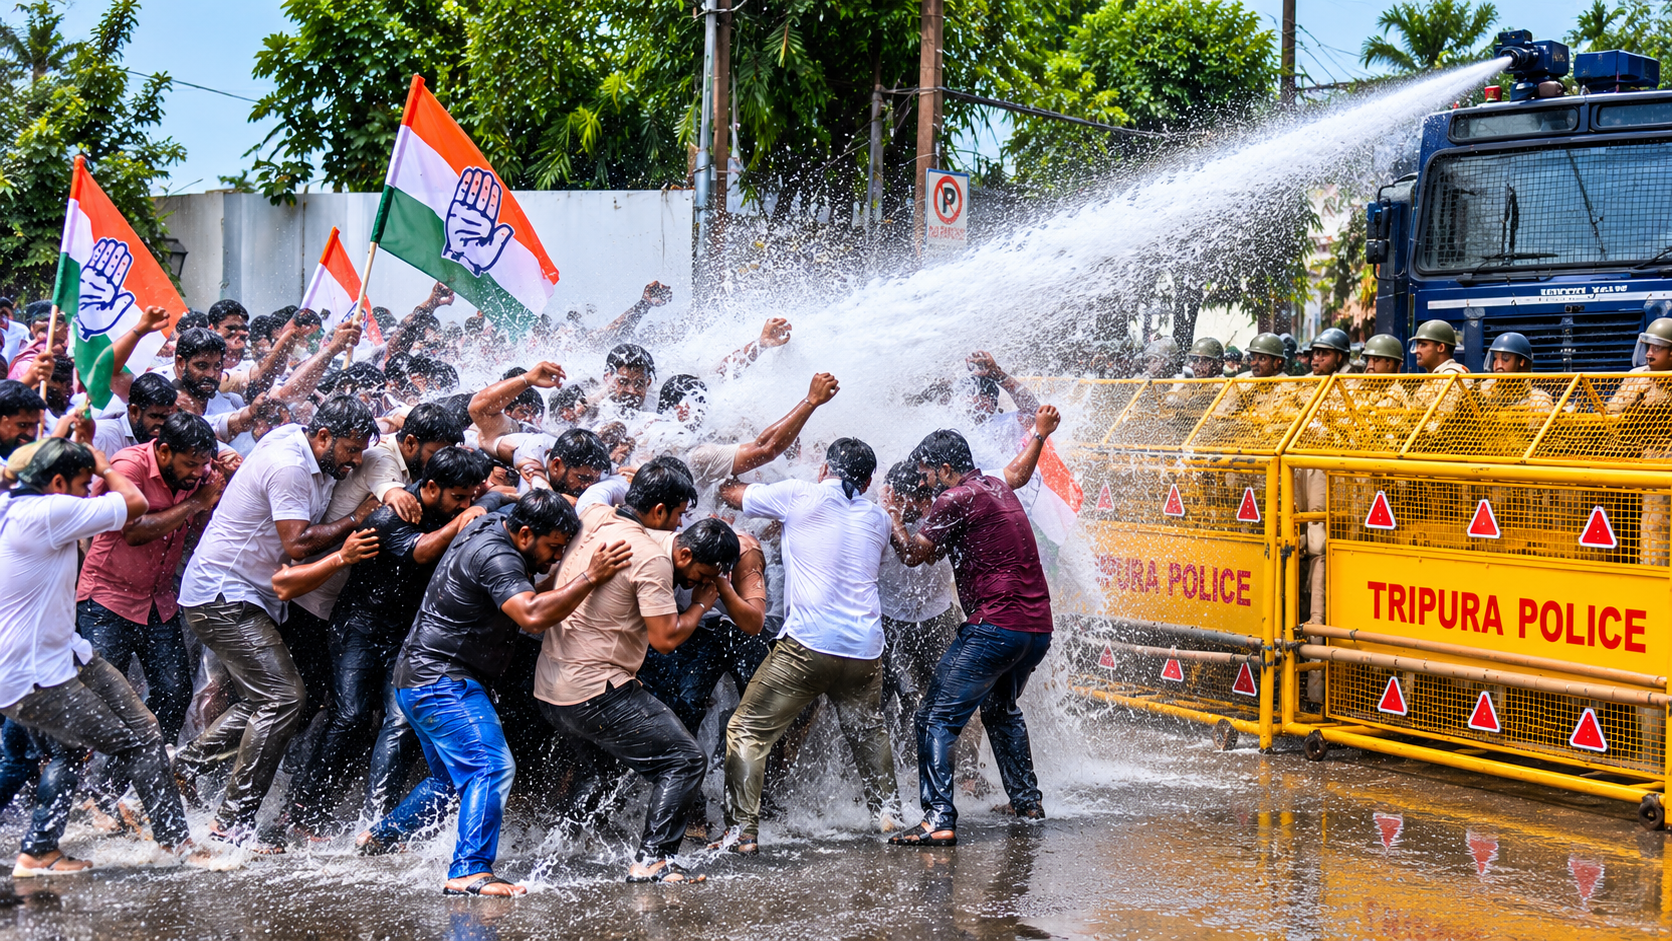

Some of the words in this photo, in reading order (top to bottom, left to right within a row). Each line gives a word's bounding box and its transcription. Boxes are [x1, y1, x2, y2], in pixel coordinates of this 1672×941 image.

[942, 187, 956, 213] P
[1095, 555, 1160, 594] PURA
[1168, 562, 1252, 607] POLICE
[1367, 581, 1504, 636] TRIPURA
[1518, 597, 1647, 654] POLICE
